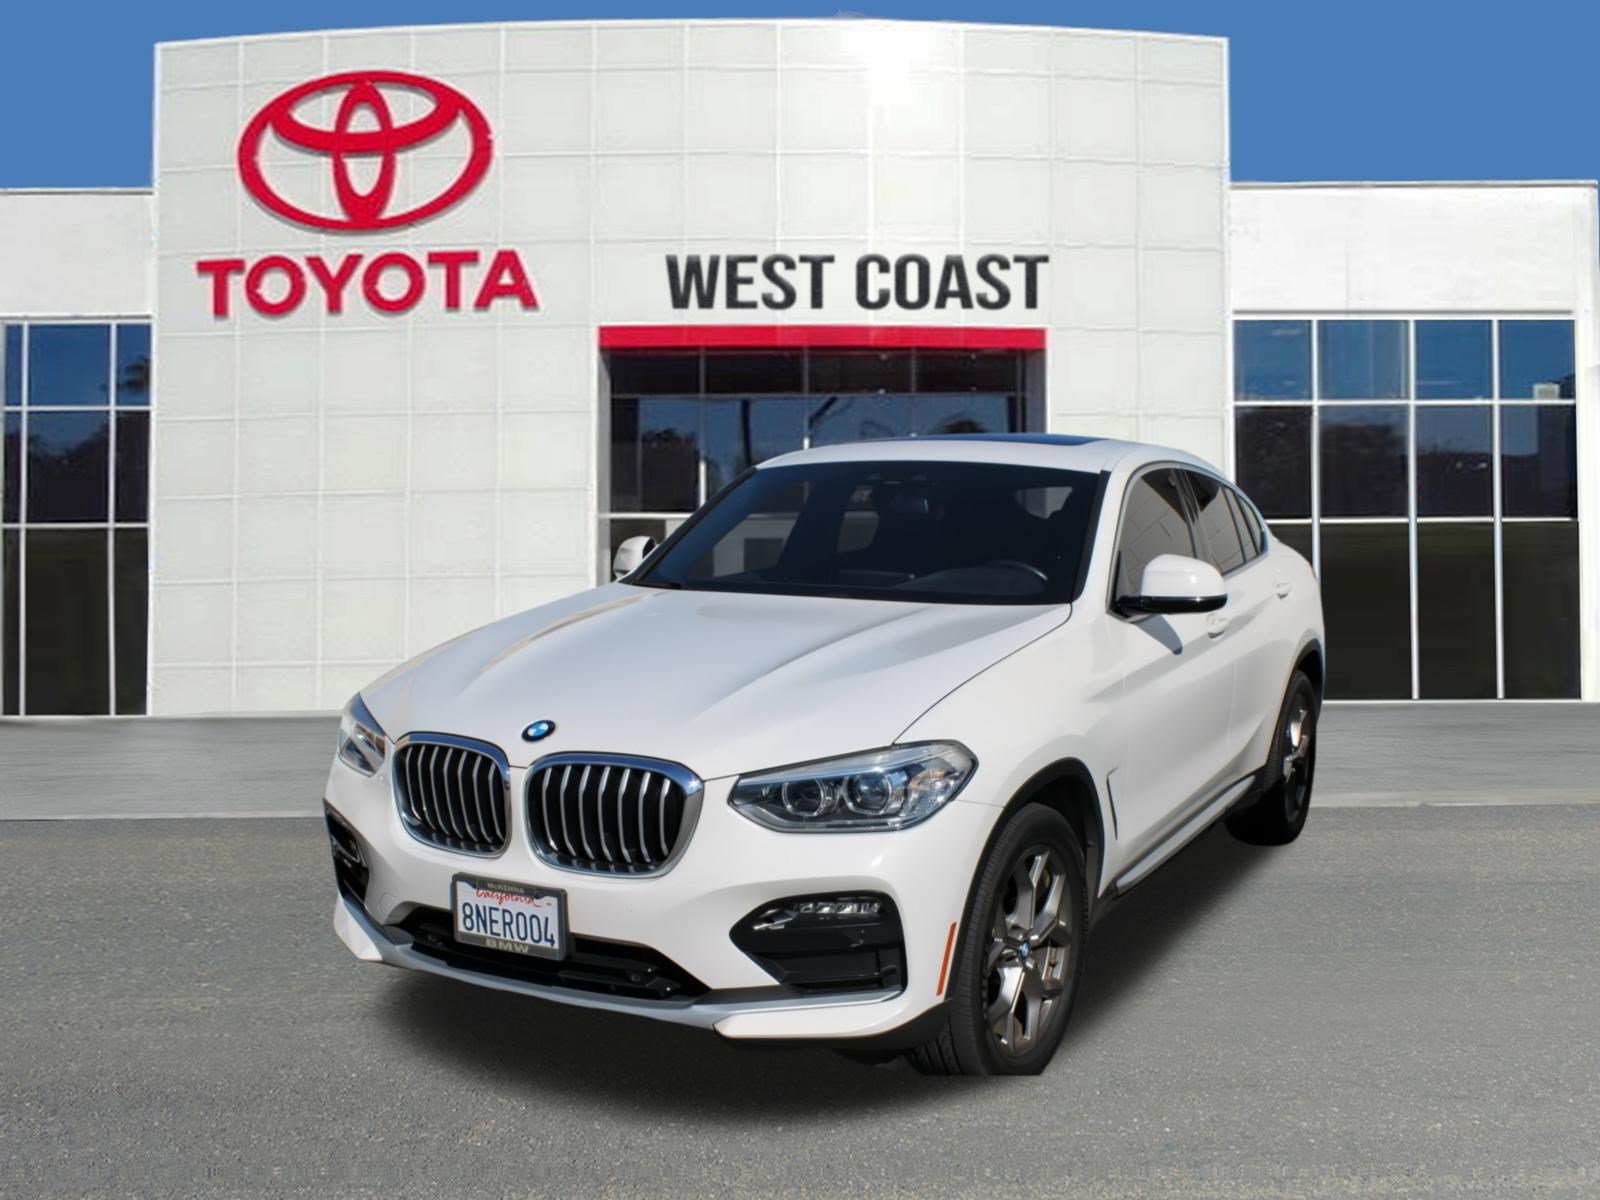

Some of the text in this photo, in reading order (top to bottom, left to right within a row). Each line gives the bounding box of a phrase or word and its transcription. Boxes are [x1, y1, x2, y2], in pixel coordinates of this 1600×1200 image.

[196, 249, 539, 318] TOYOTA
[665, 254, 1050, 310] WEST COAST
[462, 902, 555, 947] 8NER004
[486, 938, 529, 954] BMW
